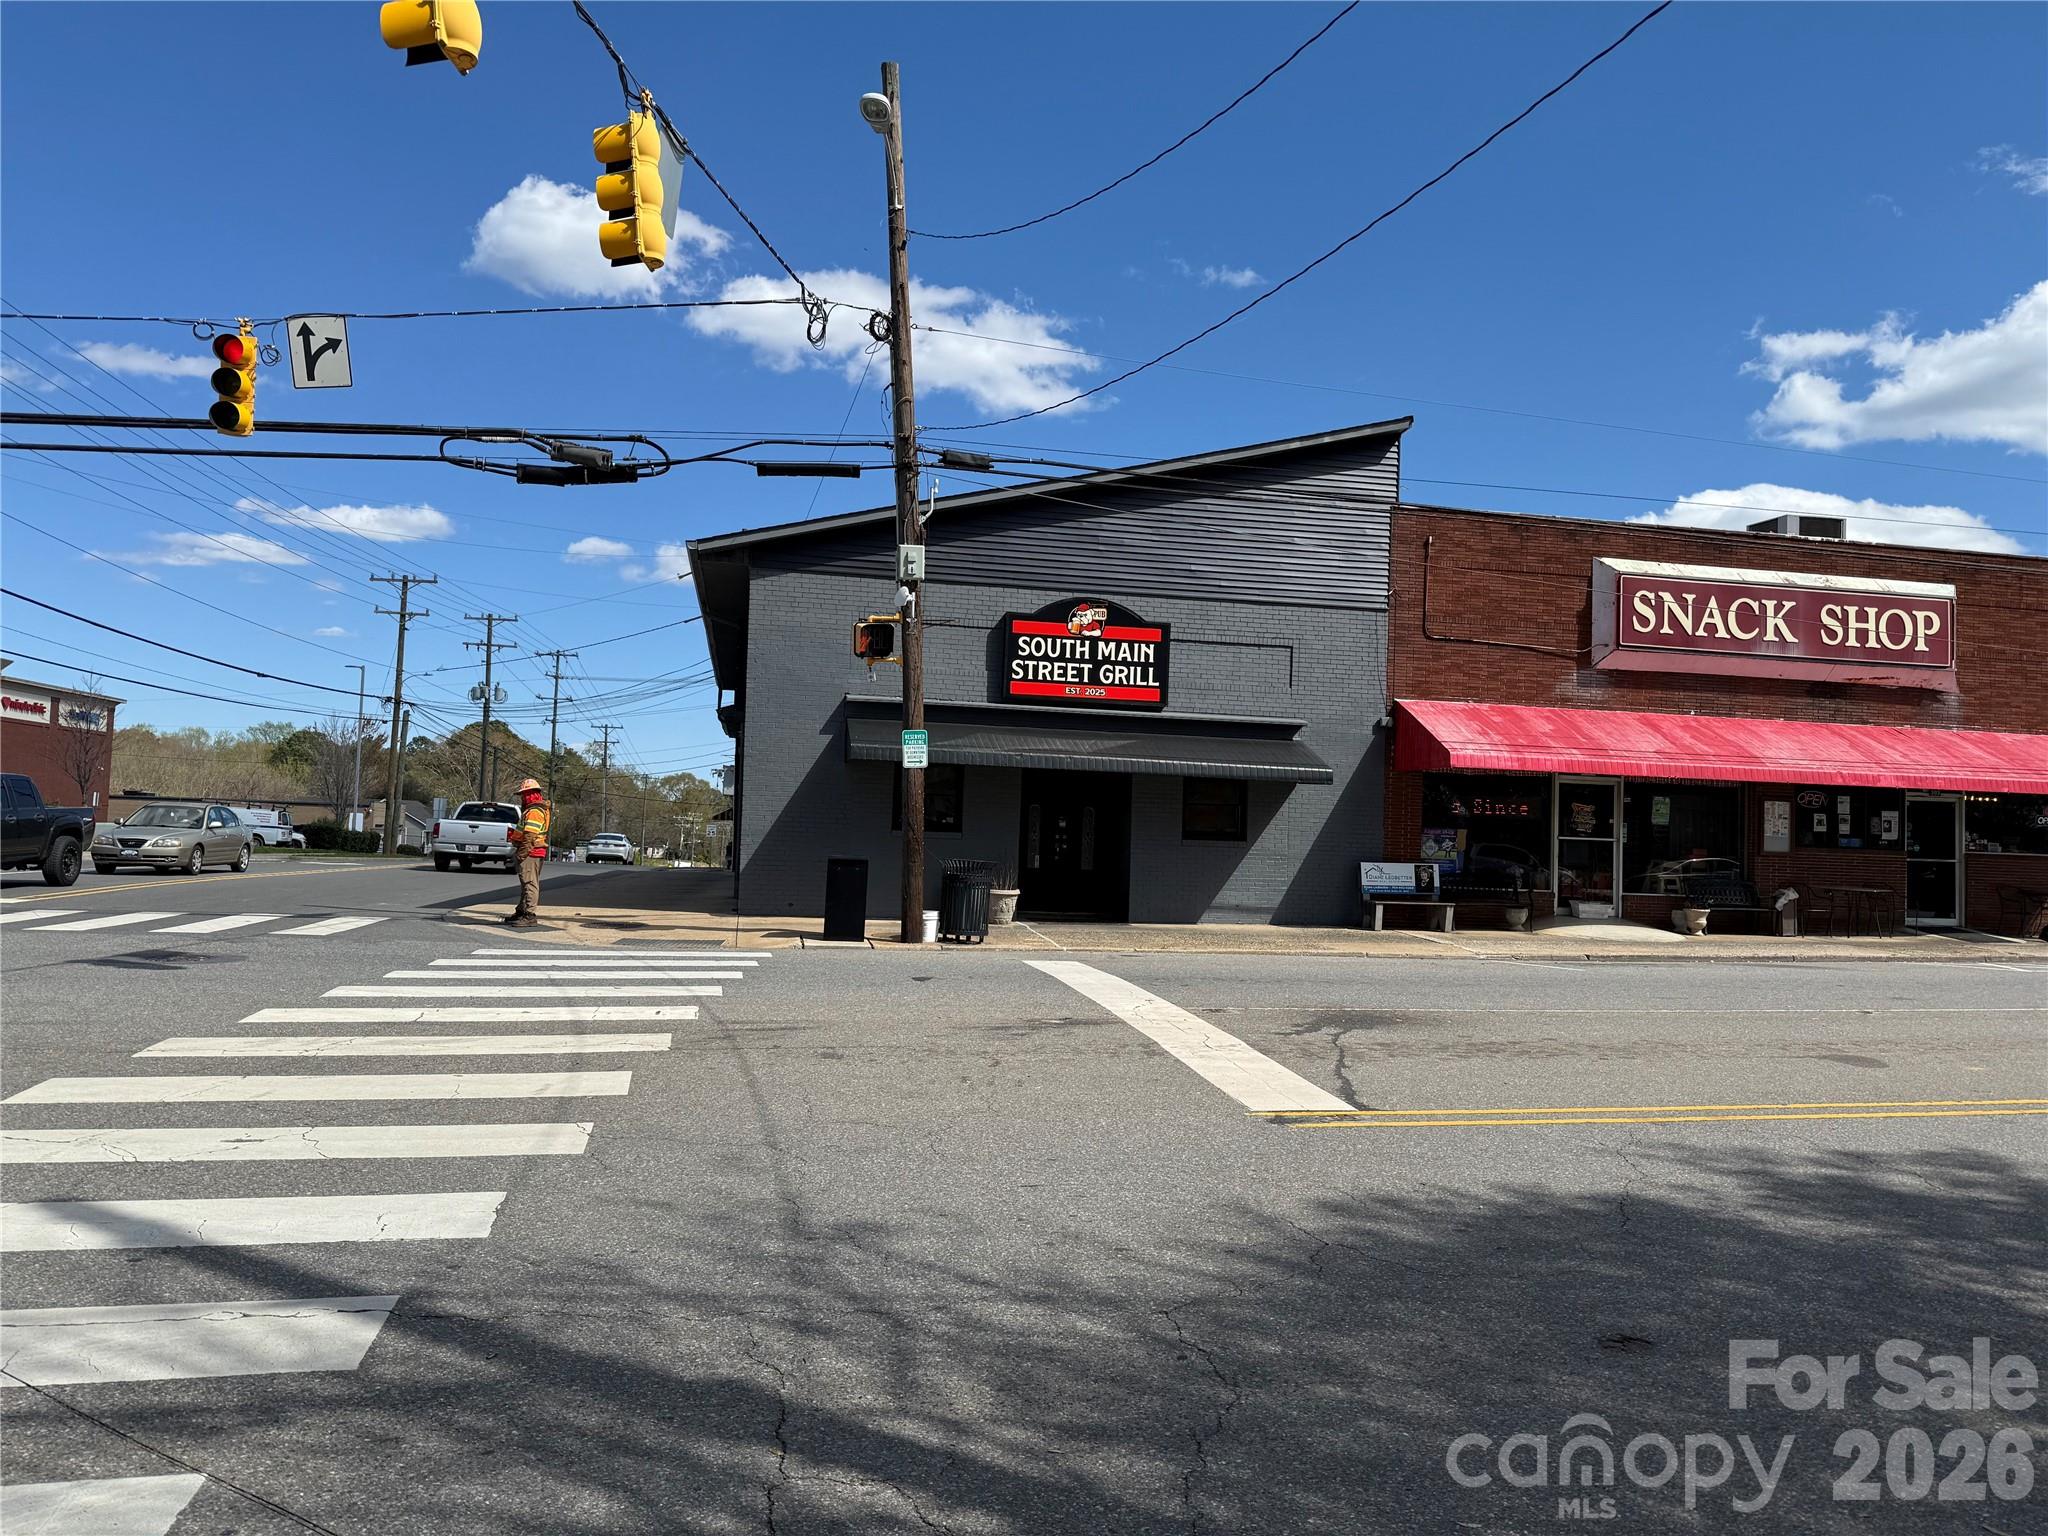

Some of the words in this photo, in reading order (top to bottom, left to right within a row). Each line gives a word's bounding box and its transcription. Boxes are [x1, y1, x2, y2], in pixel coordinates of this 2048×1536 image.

[1093, 610, 1106, 618] PUB
[1632, 590, 1799, 643] SNACK
[1820, 604, 1941, 651] SHOP
[1018, 636, 1090, 660] SOUTH
[1097, 641, 1155, 663] MAIN
[1011, 660, 1093, 682] STREET
[1099, 665, 1160, 687] GRILL
[1065, 687, 1083, 695] EST.
[1085, 688, 1106, 696] 2025
[1798, 793, 1828, 806] OPEN
[1473, 799, 1529, 815] Since
[2038, 816, 2048, 824] OP
